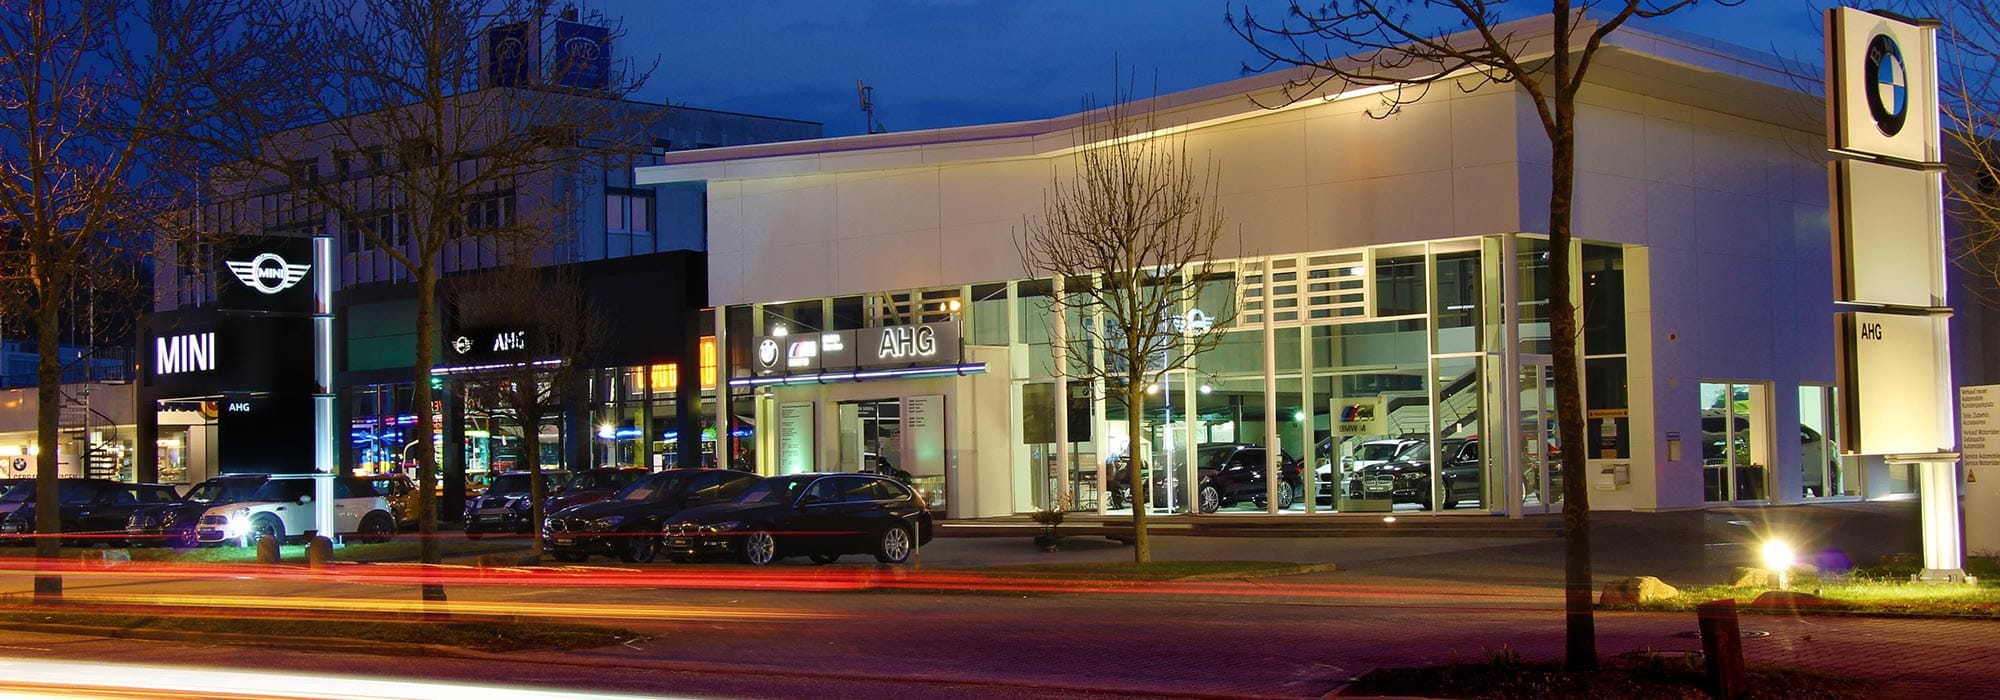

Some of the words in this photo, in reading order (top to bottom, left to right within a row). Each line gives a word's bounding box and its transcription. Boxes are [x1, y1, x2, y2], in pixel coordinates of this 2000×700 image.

[258, 268, 284, 279] MINI
[1861, 322, 1882, 340] AHG
[493, 331, 525, 352] AHG
[878, 325, 936, 358] AHG
[157, 332, 215, 375] MINI
[229, 403, 250, 412] AHG
